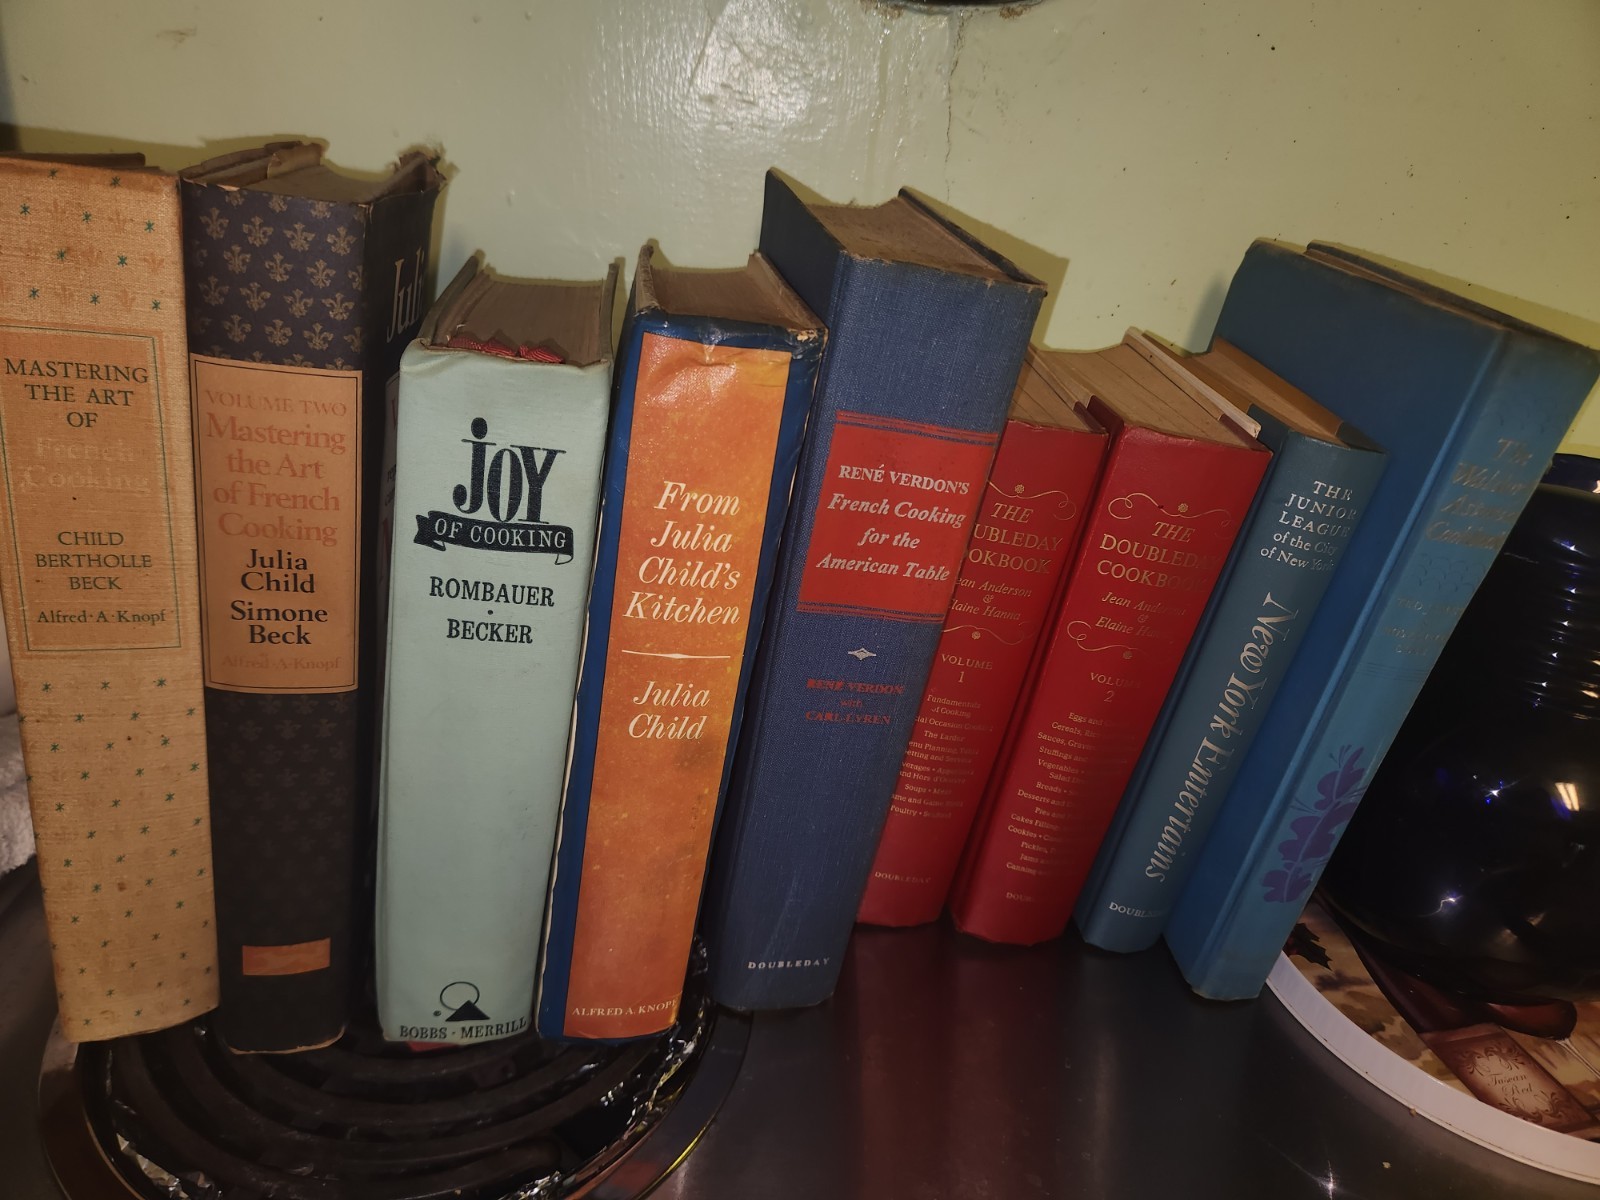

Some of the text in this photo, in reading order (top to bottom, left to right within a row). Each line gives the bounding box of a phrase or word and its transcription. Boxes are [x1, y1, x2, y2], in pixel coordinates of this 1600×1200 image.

[5, 358, 149, 384] MASTERING
[25, 383, 134, 407] THE ART
[203, 389, 348, 418] VOLUME TWO
[66, 411, 99, 428] OF
[206, 413, 346, 455] Mastering
[227, 449, 324, 480] the Art
[838, 464, 970, 495] RENÉ VERDON'S
[213, 481, 340, 511] of French
[653, 481, 740, 516] From
[1285, 493, 1357, 520] JUNIOR
[827, 493, 966, 529] French Cooking
[991, 502, 1034, 523] THE
[218, 512, 339, 548] Cooking
[434, 517, 567, 549] OF COOKING
[1152, 521, 1195, 543] THE
[1279, 510, 1351, 537] LEAGUE
[57, 531, 125, 546] CHILD
[650, 520, 733, 553] Julia
[857, 527, 921, 549] for the
[974, 523, 1063, 551] UBLEDAY
[1273, 531, 1290, 544] of
[1290, 535, 1312, 551] the
[35, 552, 153, 569] BERTHOLLE
[246, 549, 309, 571] Julia
[816, 552, 950, 581] American Table
[969, 548, 1052, 574] OKBOOK
[1260, 546, 1277, 559] of
[1276, 550, 1309, 569] New
[69, 575, 122, 591] BECK
[241, 571, 316, 594] Child
[638, 556, 741, 591] Child's
[429, 576, 555, 607] ROMBAUER
[957, 577, 1033, 597] ean Anderson
[983, 594, 994, 603] &
[230, 599, 329, 623] Simone
[623, 591, 741, 626] Kitchen
[951, 599, 980, 615] laine
[1102, 592, 1131, 608] Jean
[117, 609, 166, 627] Knopf
[1095, 616, 1134, 634] Elaine
[249, 624, 312, 645] Beck
[446, 618, 533, 644] BECKER
[941, 653, 993, 670] VOLUME
[958, 671, 965, 683] 1
[632, 681, 711, 708] Julia
[1104, 690, 1115, 702] 2
[628, 713, 707, 741] Child
[924, 730, 938, 739] The
[1145, 591, 1299, 883] New York Entertains
[905, 750, 928, 760] etting
[908, 740, 923, 749] enu
[902, 762, 930, 772] verages
[891, 805, 917, 817] Poultry
[748, 957, 829, 969] DOUBLEDAY
[572, 1007, 623, 1016] ALFRED
[638, 998, 678, 1014] KNOPF
[400, 1016, 526, 1039] BOBBS MERRILL
